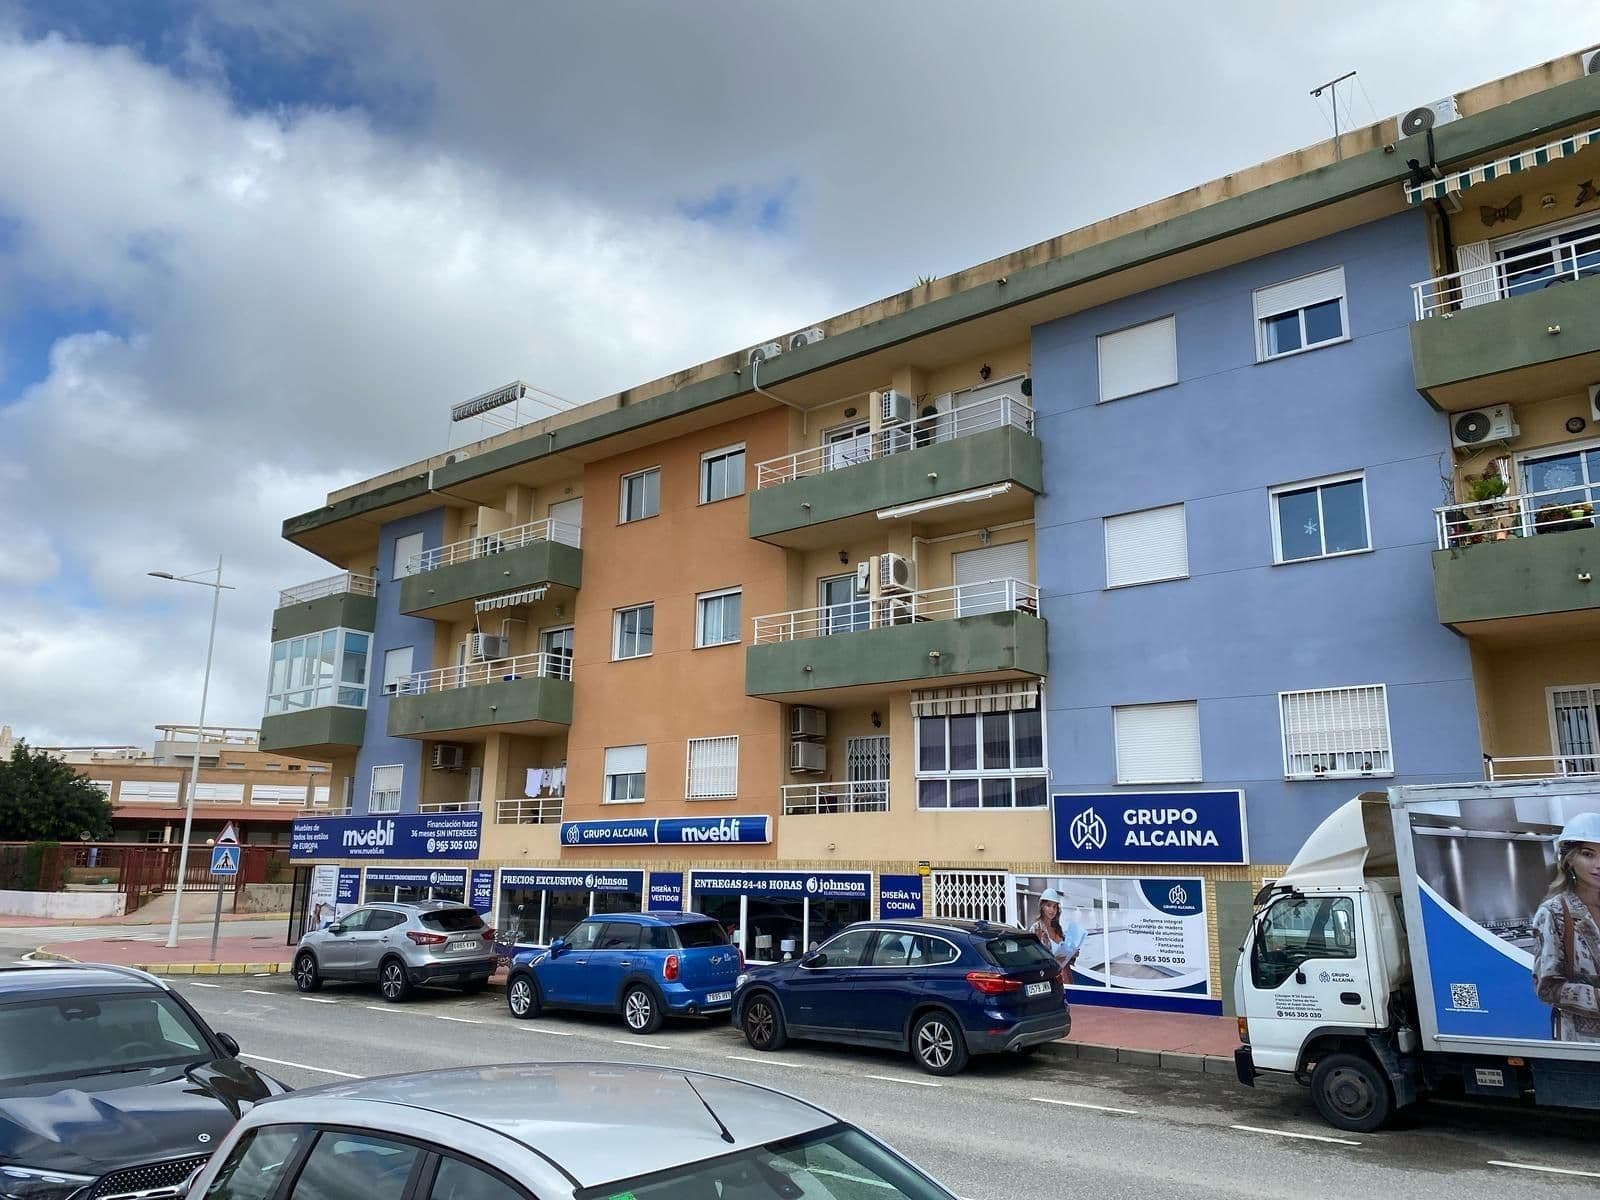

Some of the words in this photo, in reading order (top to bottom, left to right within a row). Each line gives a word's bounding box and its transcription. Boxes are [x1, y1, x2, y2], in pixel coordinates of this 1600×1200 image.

[1123, 808, 1198, 825] GRUPO
[294, 824, 313, 832] Muebles
[427, 819, 460, 828] Financiación
[461, 820, 477, 828] hasta
[342, 819, 395, 846] muebli
[446, 829, 477, 837] INTERESES
[583, 829, 612, 839] GRUPO
[612, 828, 648, 838] ALCAINA
[682, 819, 740, 842] muebli
[293, 833, 306, 841] todos
[1124, 830, 1219, 847] ALCAINA
[299, 842, 318, 850] EUROPA
[436, 841, 449, 850] 965
[450, 841, 463, 850] 305
[464, 841, 478, 850] 030
[437, 872, 464, 884] johnson
[502, 875, 535, 885] PRECIOS
[535, 876, 583, 886] EXCLUSIVOS
[594, 875, 628, 887] johnson
[651, 885, 672, 893] DISEÑA
[694, 879, 742, 889] ENTREGAS
[742, 880, 767, 889] 24-48
[769, 880, 803, 890] HORAS
[818, 879, 866, 893] johnson
[881, 889, 909, 899] DISEÑA
[910, 892, 921, 900] TU
[886, 902, 916, 910] COCINA
[1143, 955, 1157, 963] 965
[1158, 956, 1171, 964] 305
